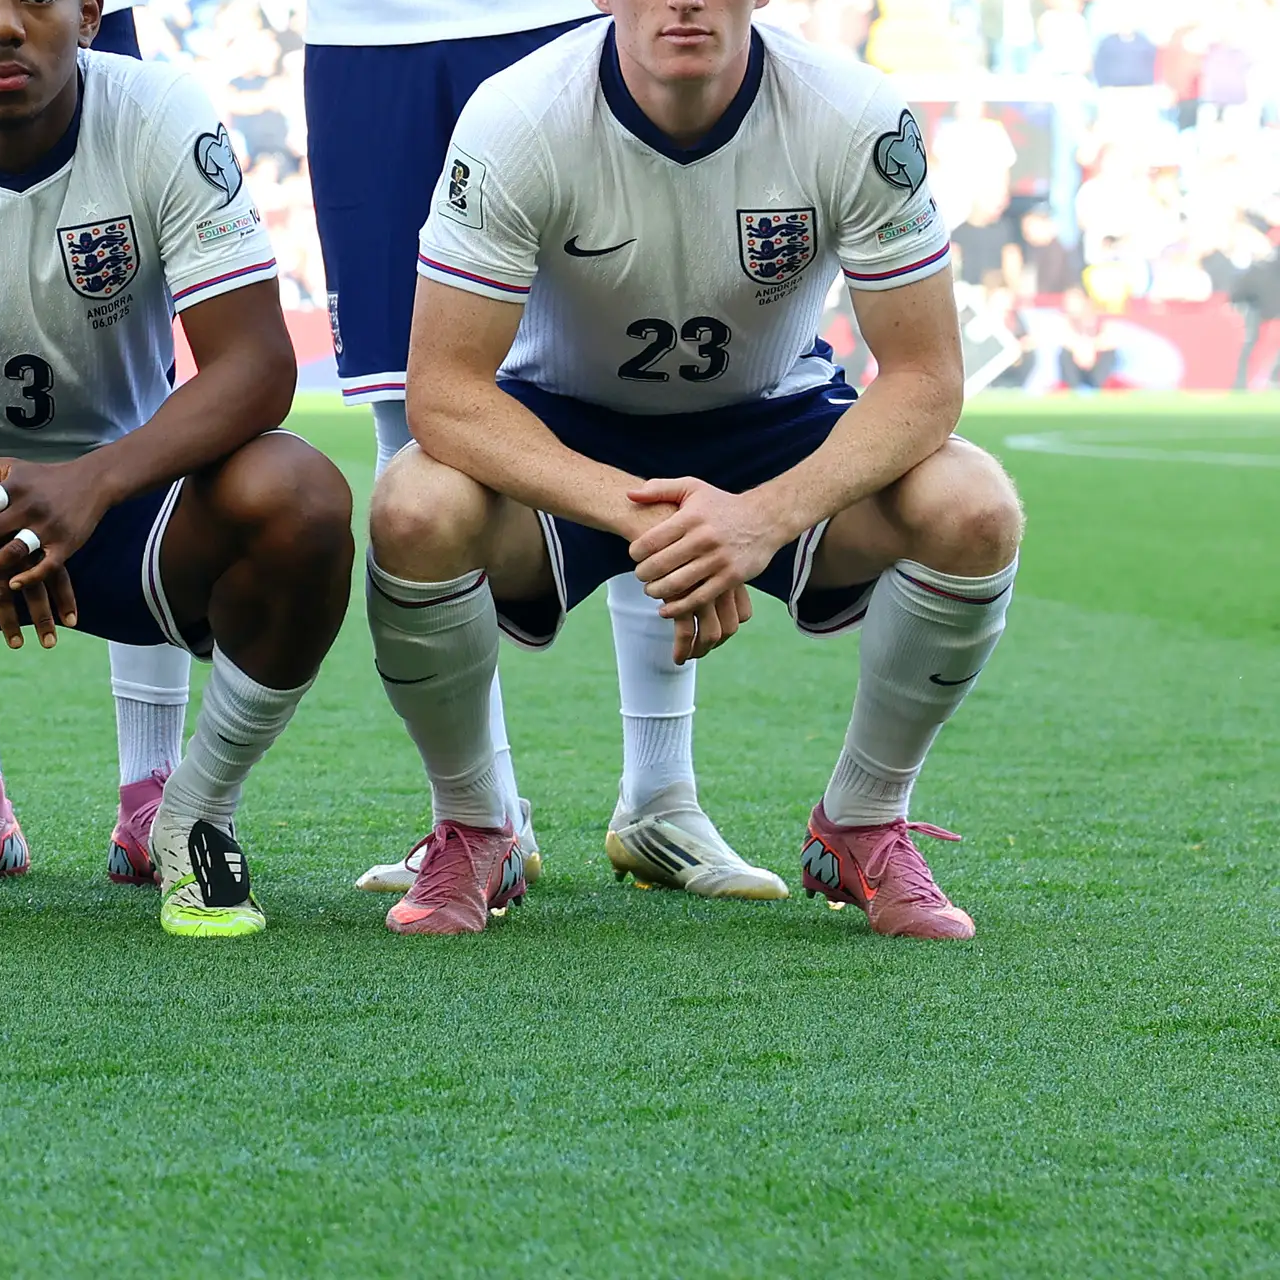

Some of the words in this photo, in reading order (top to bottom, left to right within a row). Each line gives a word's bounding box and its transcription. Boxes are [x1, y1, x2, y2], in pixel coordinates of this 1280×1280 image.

[87, 293, 134, 320] ANDORRA
[92, 304, 130, 329] 06.09.25
[618, 316, 732, 383] 23
[3, 354, 55, 430] 3
